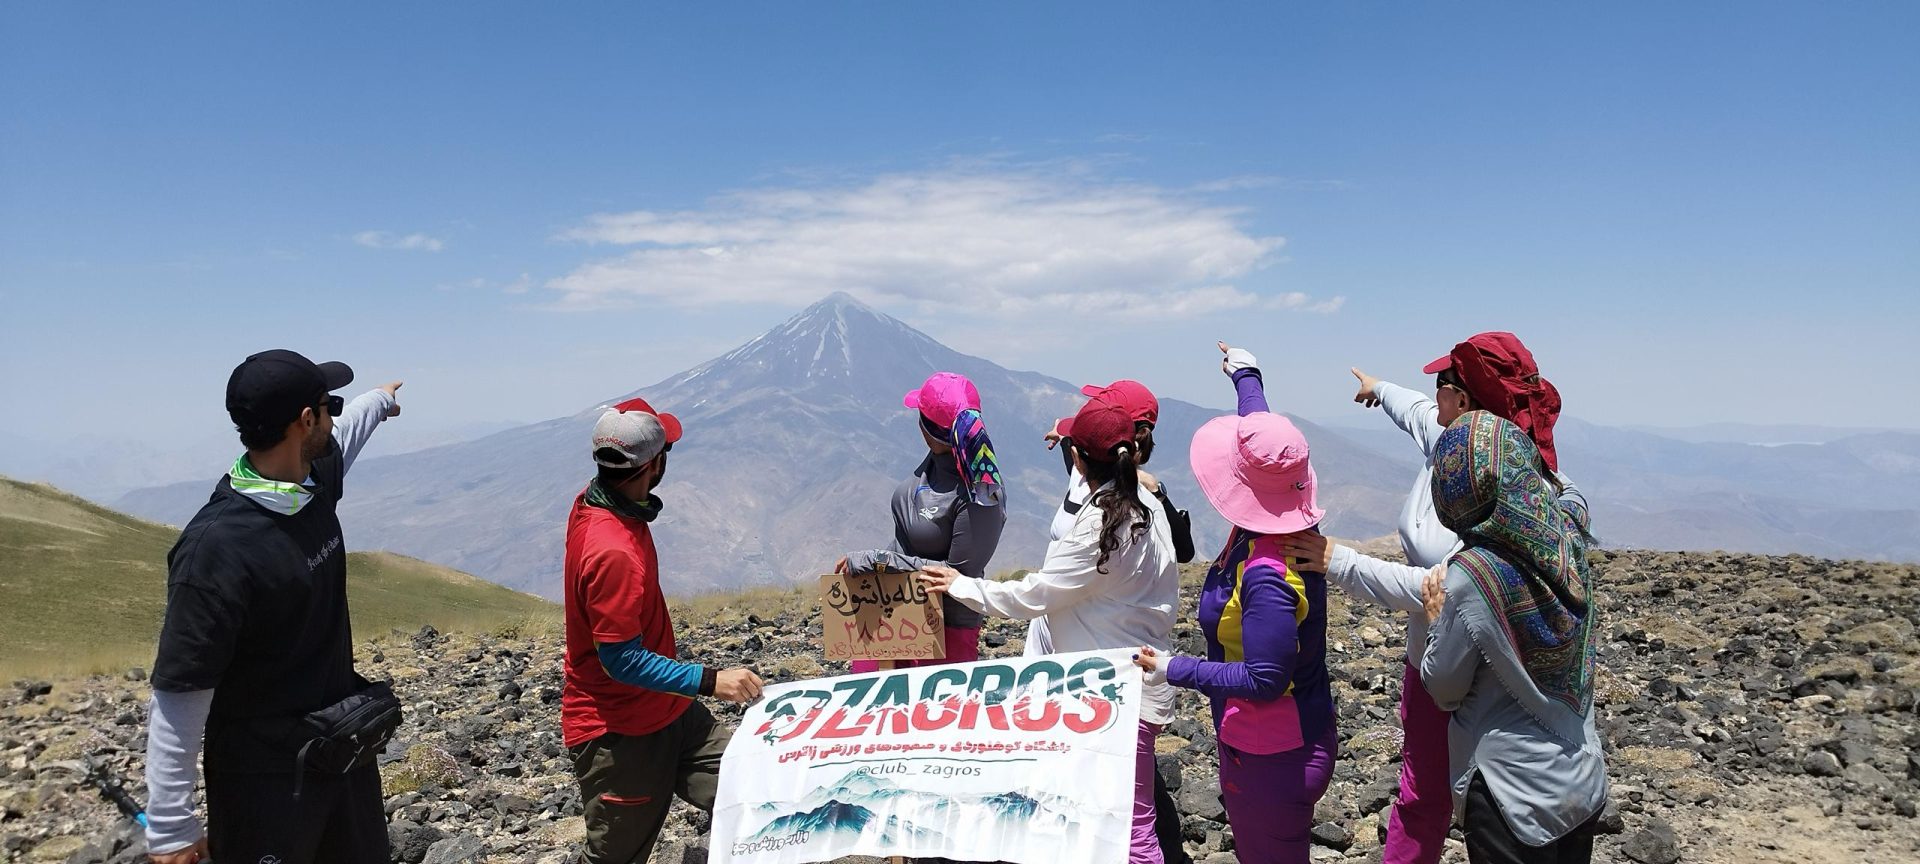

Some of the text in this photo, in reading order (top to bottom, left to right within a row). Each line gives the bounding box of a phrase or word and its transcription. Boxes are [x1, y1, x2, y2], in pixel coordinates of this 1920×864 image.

[826, 574, 929, 618] قله پاشوره
[844, 618, 919, 644] ۳۸۵۵
[811, 656, 1118, 740] ZAGROS
[778, 745, 817, 763] زاگرس
[820, 744, 861, 759] ورزشی
[939, 743, 947, 752] و
[950, 740, 1021, 754] کوهنوردی
[1024, 740, 1071, 753] باشگاه
[857, 762, 982, 779] @club_ zagros
